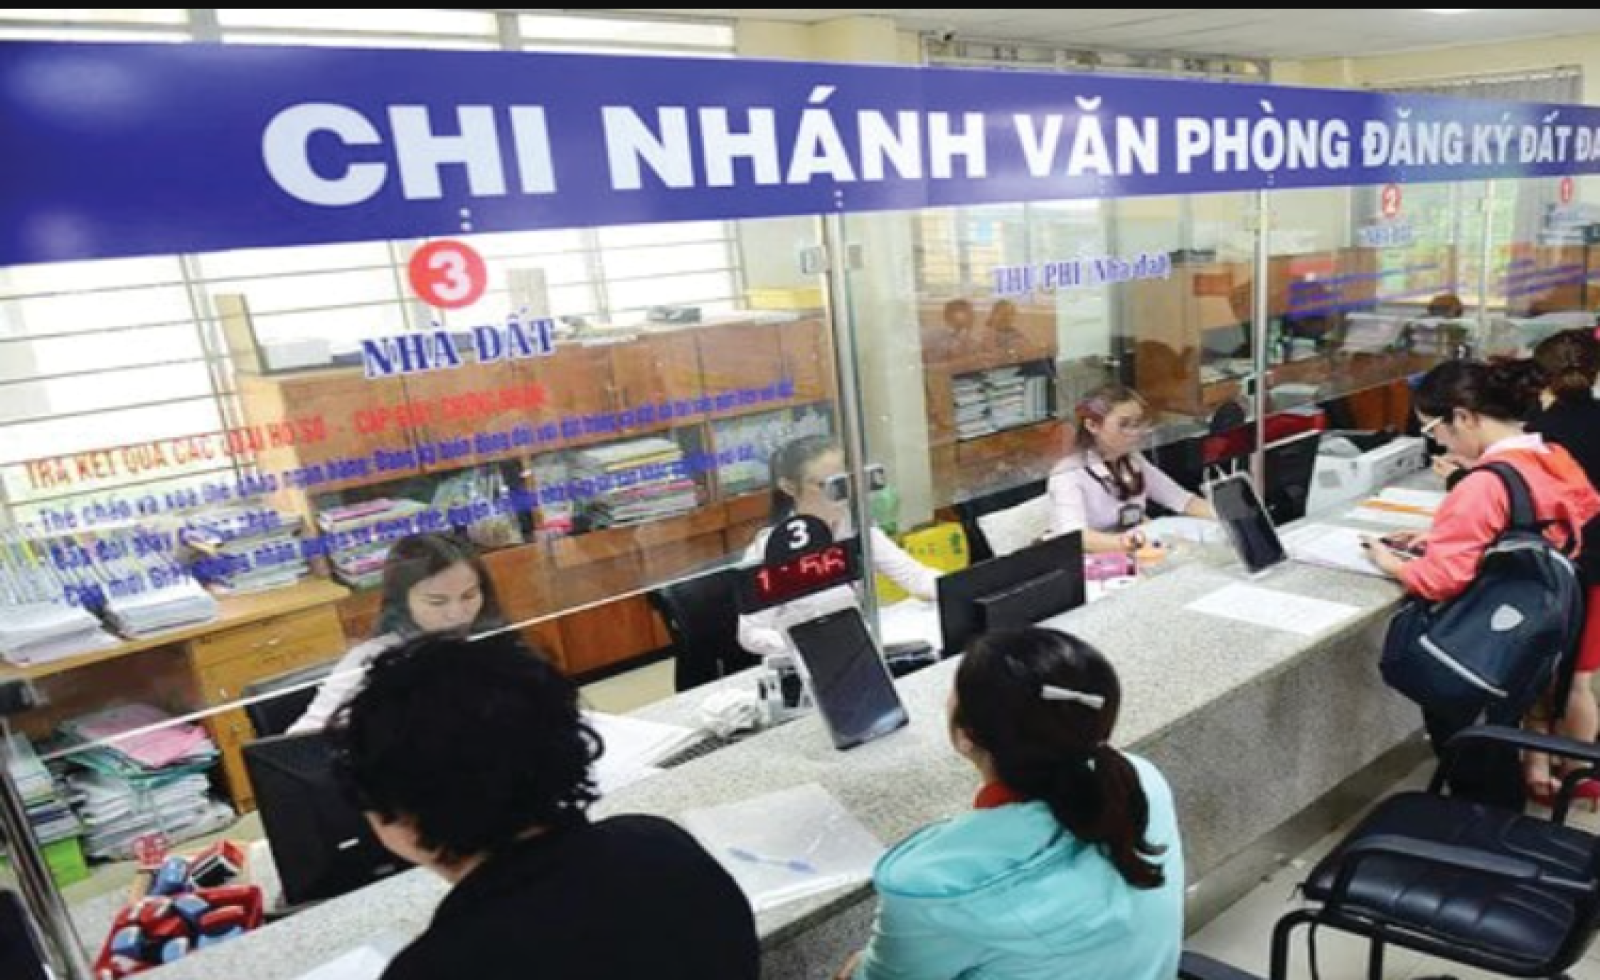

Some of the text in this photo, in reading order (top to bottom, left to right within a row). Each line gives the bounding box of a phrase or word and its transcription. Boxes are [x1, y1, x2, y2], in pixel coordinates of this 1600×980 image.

[261, 102, 557, 206] CHI
[601, 84, 987, 190] NHÁNH
[1013, 96, 1159, 177] VĂN
[1175, 99, 1350, 174] PHÒNG
[1363, 107, 1464, 167] ĐĂNG
[1471, 111, 1515, 165] KÝ
[1518, 110, 1573, 163] ĐẤT
[1384, 186, 1398, 215] 2
[427, 250, 472, 301] 3
[361, 321, 462, 378] NHÀ
[786, 519, 811, 550] 3
